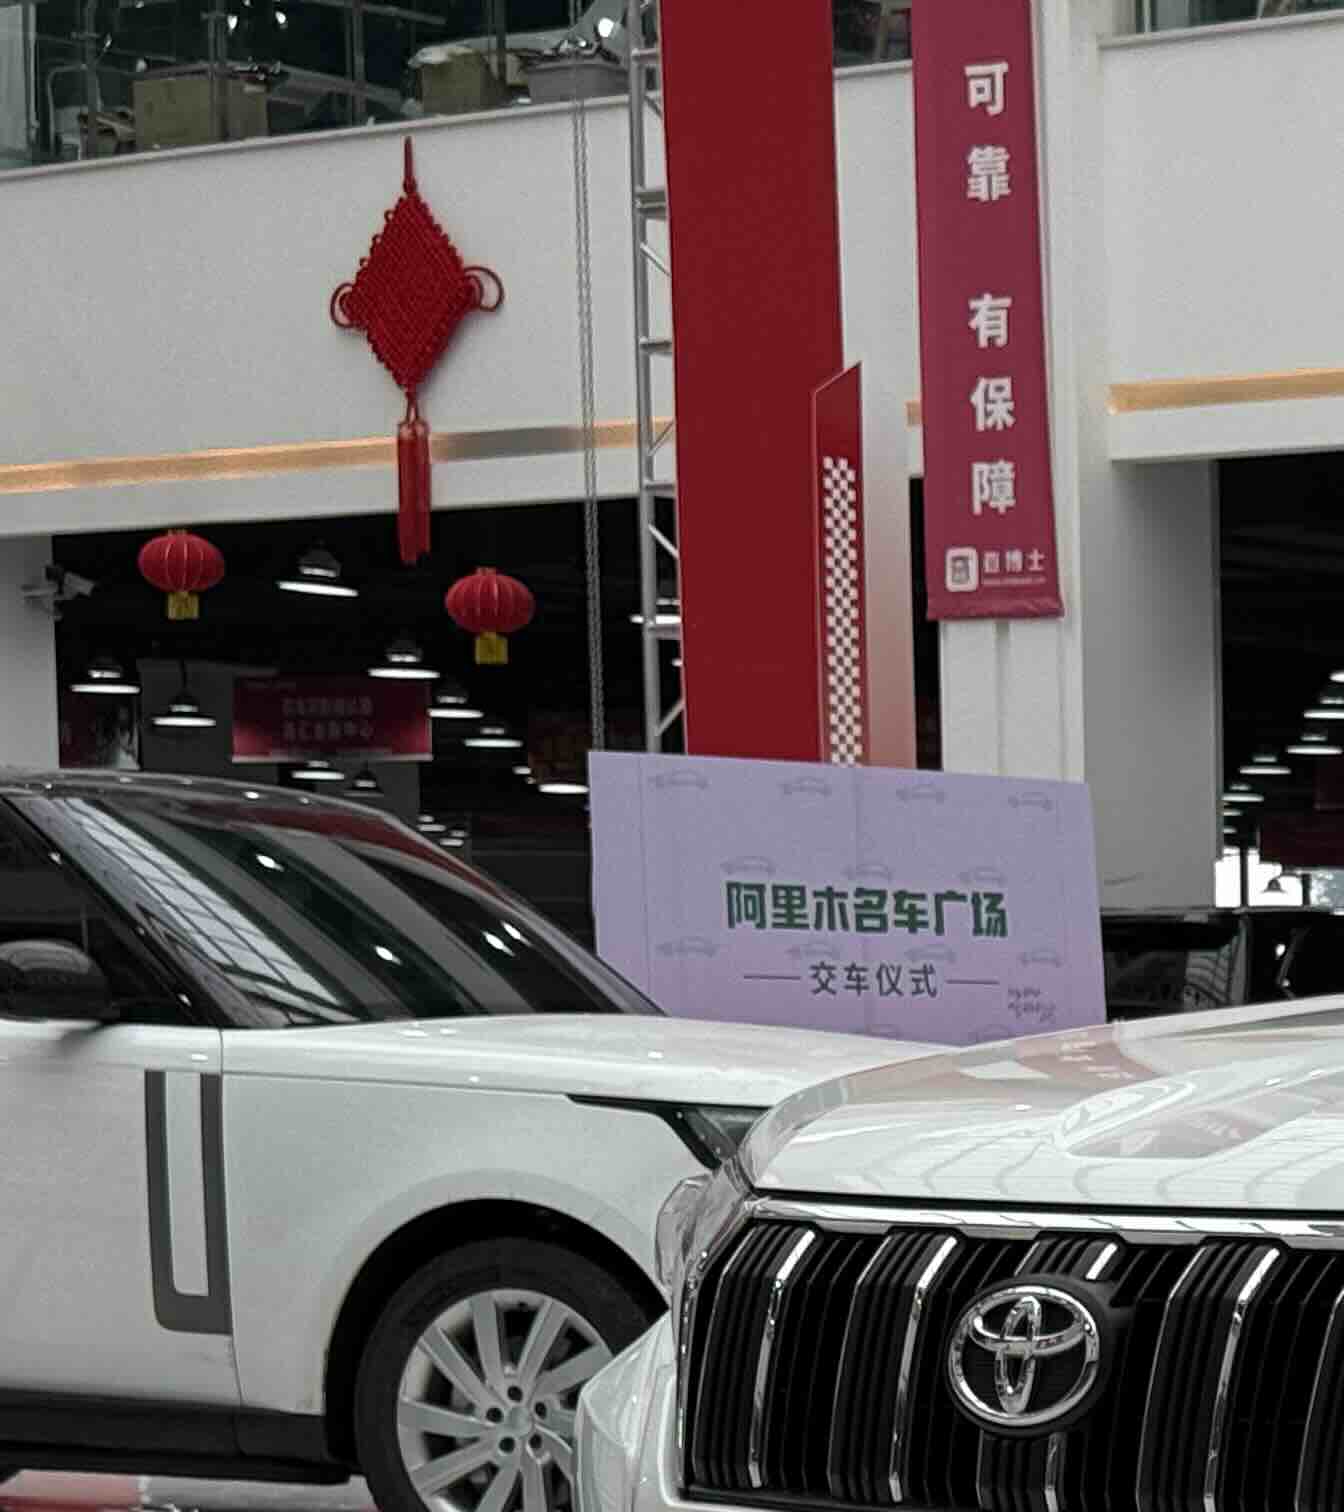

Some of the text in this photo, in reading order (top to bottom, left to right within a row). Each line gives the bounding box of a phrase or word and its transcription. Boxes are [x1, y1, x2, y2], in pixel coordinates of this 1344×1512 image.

[964, 61, 1018, 517] 可靠 有保障
[725, 880, 1009, 939] 阿里木名车广场
[809, 960, 938, 998] 交车仪式
